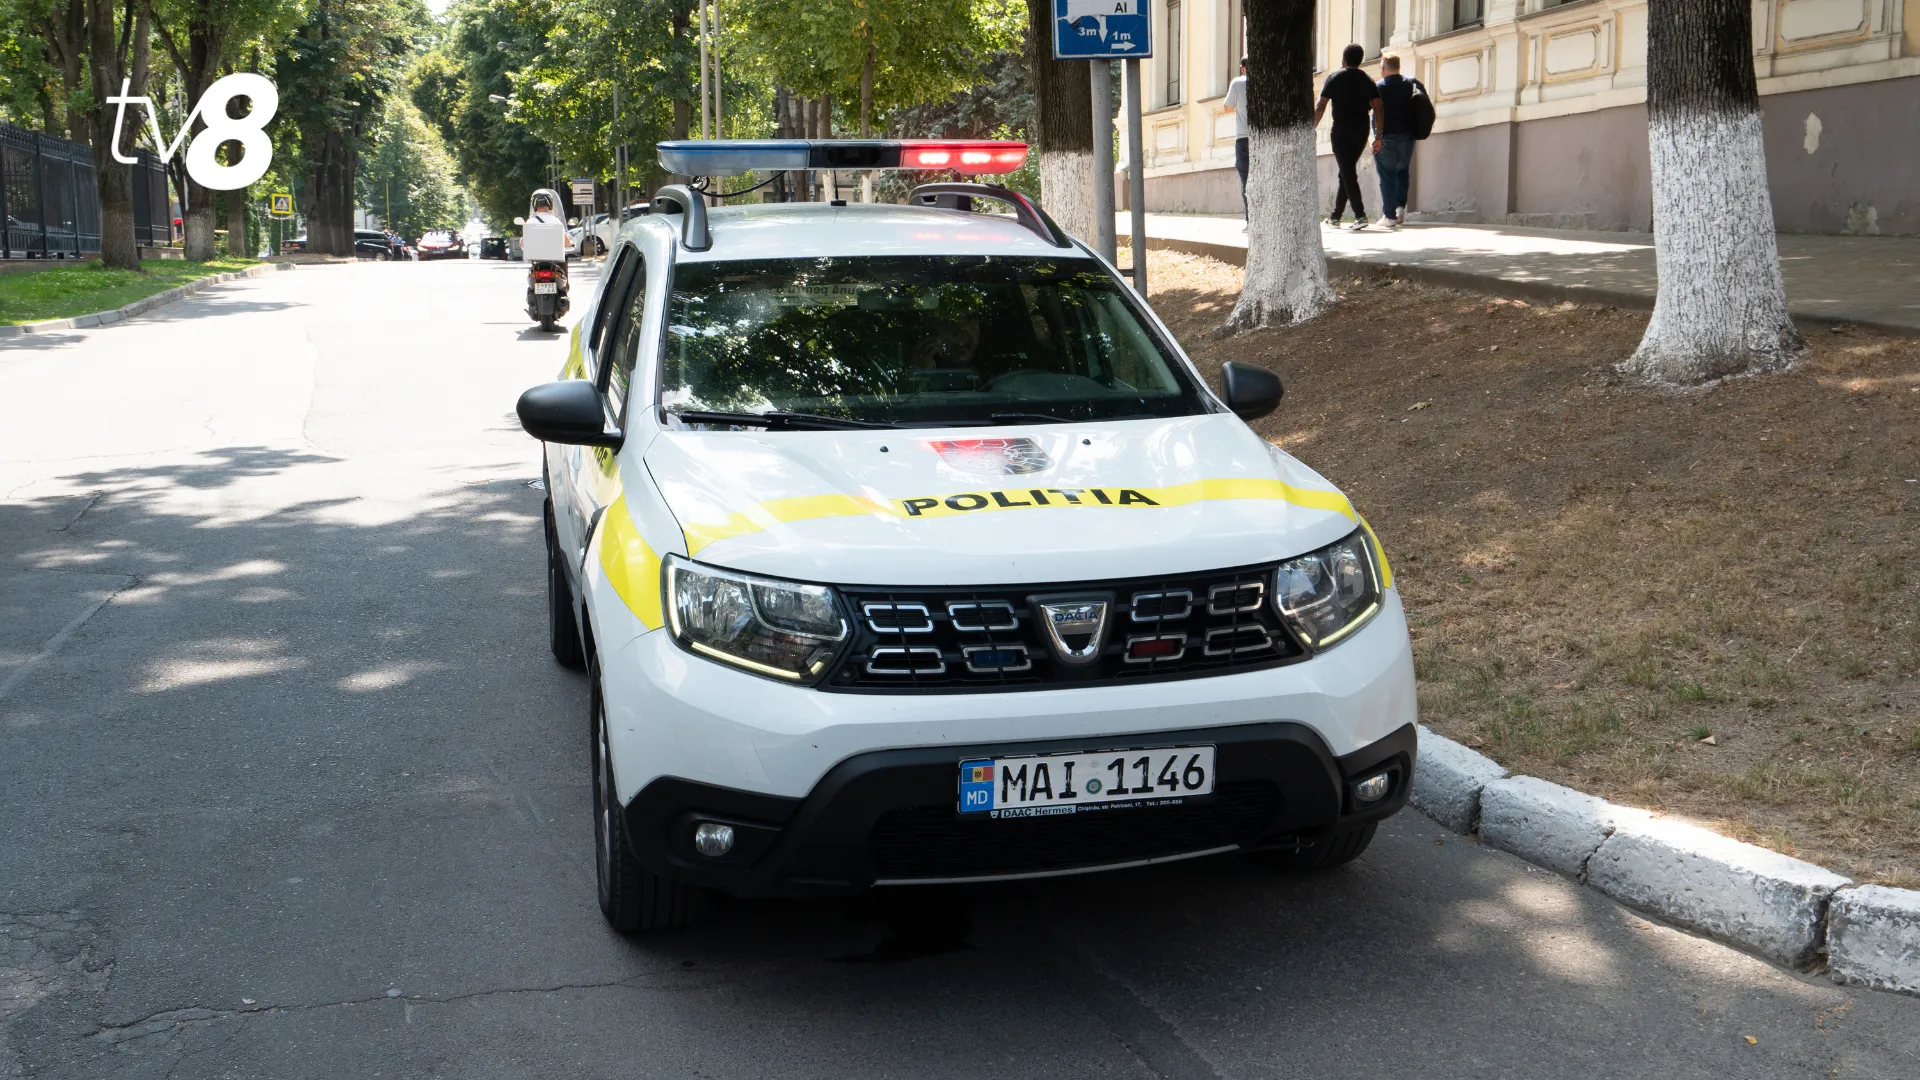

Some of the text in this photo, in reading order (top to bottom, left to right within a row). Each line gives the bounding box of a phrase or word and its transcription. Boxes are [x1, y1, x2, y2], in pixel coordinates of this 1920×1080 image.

[1055, 611, 1099, 622] DACIA
[1001, 753, 1205, 803] MAI 1146
[966, 790, 988, 806] MD
[1003, 806, 1073, 818] DAAC Hermes
